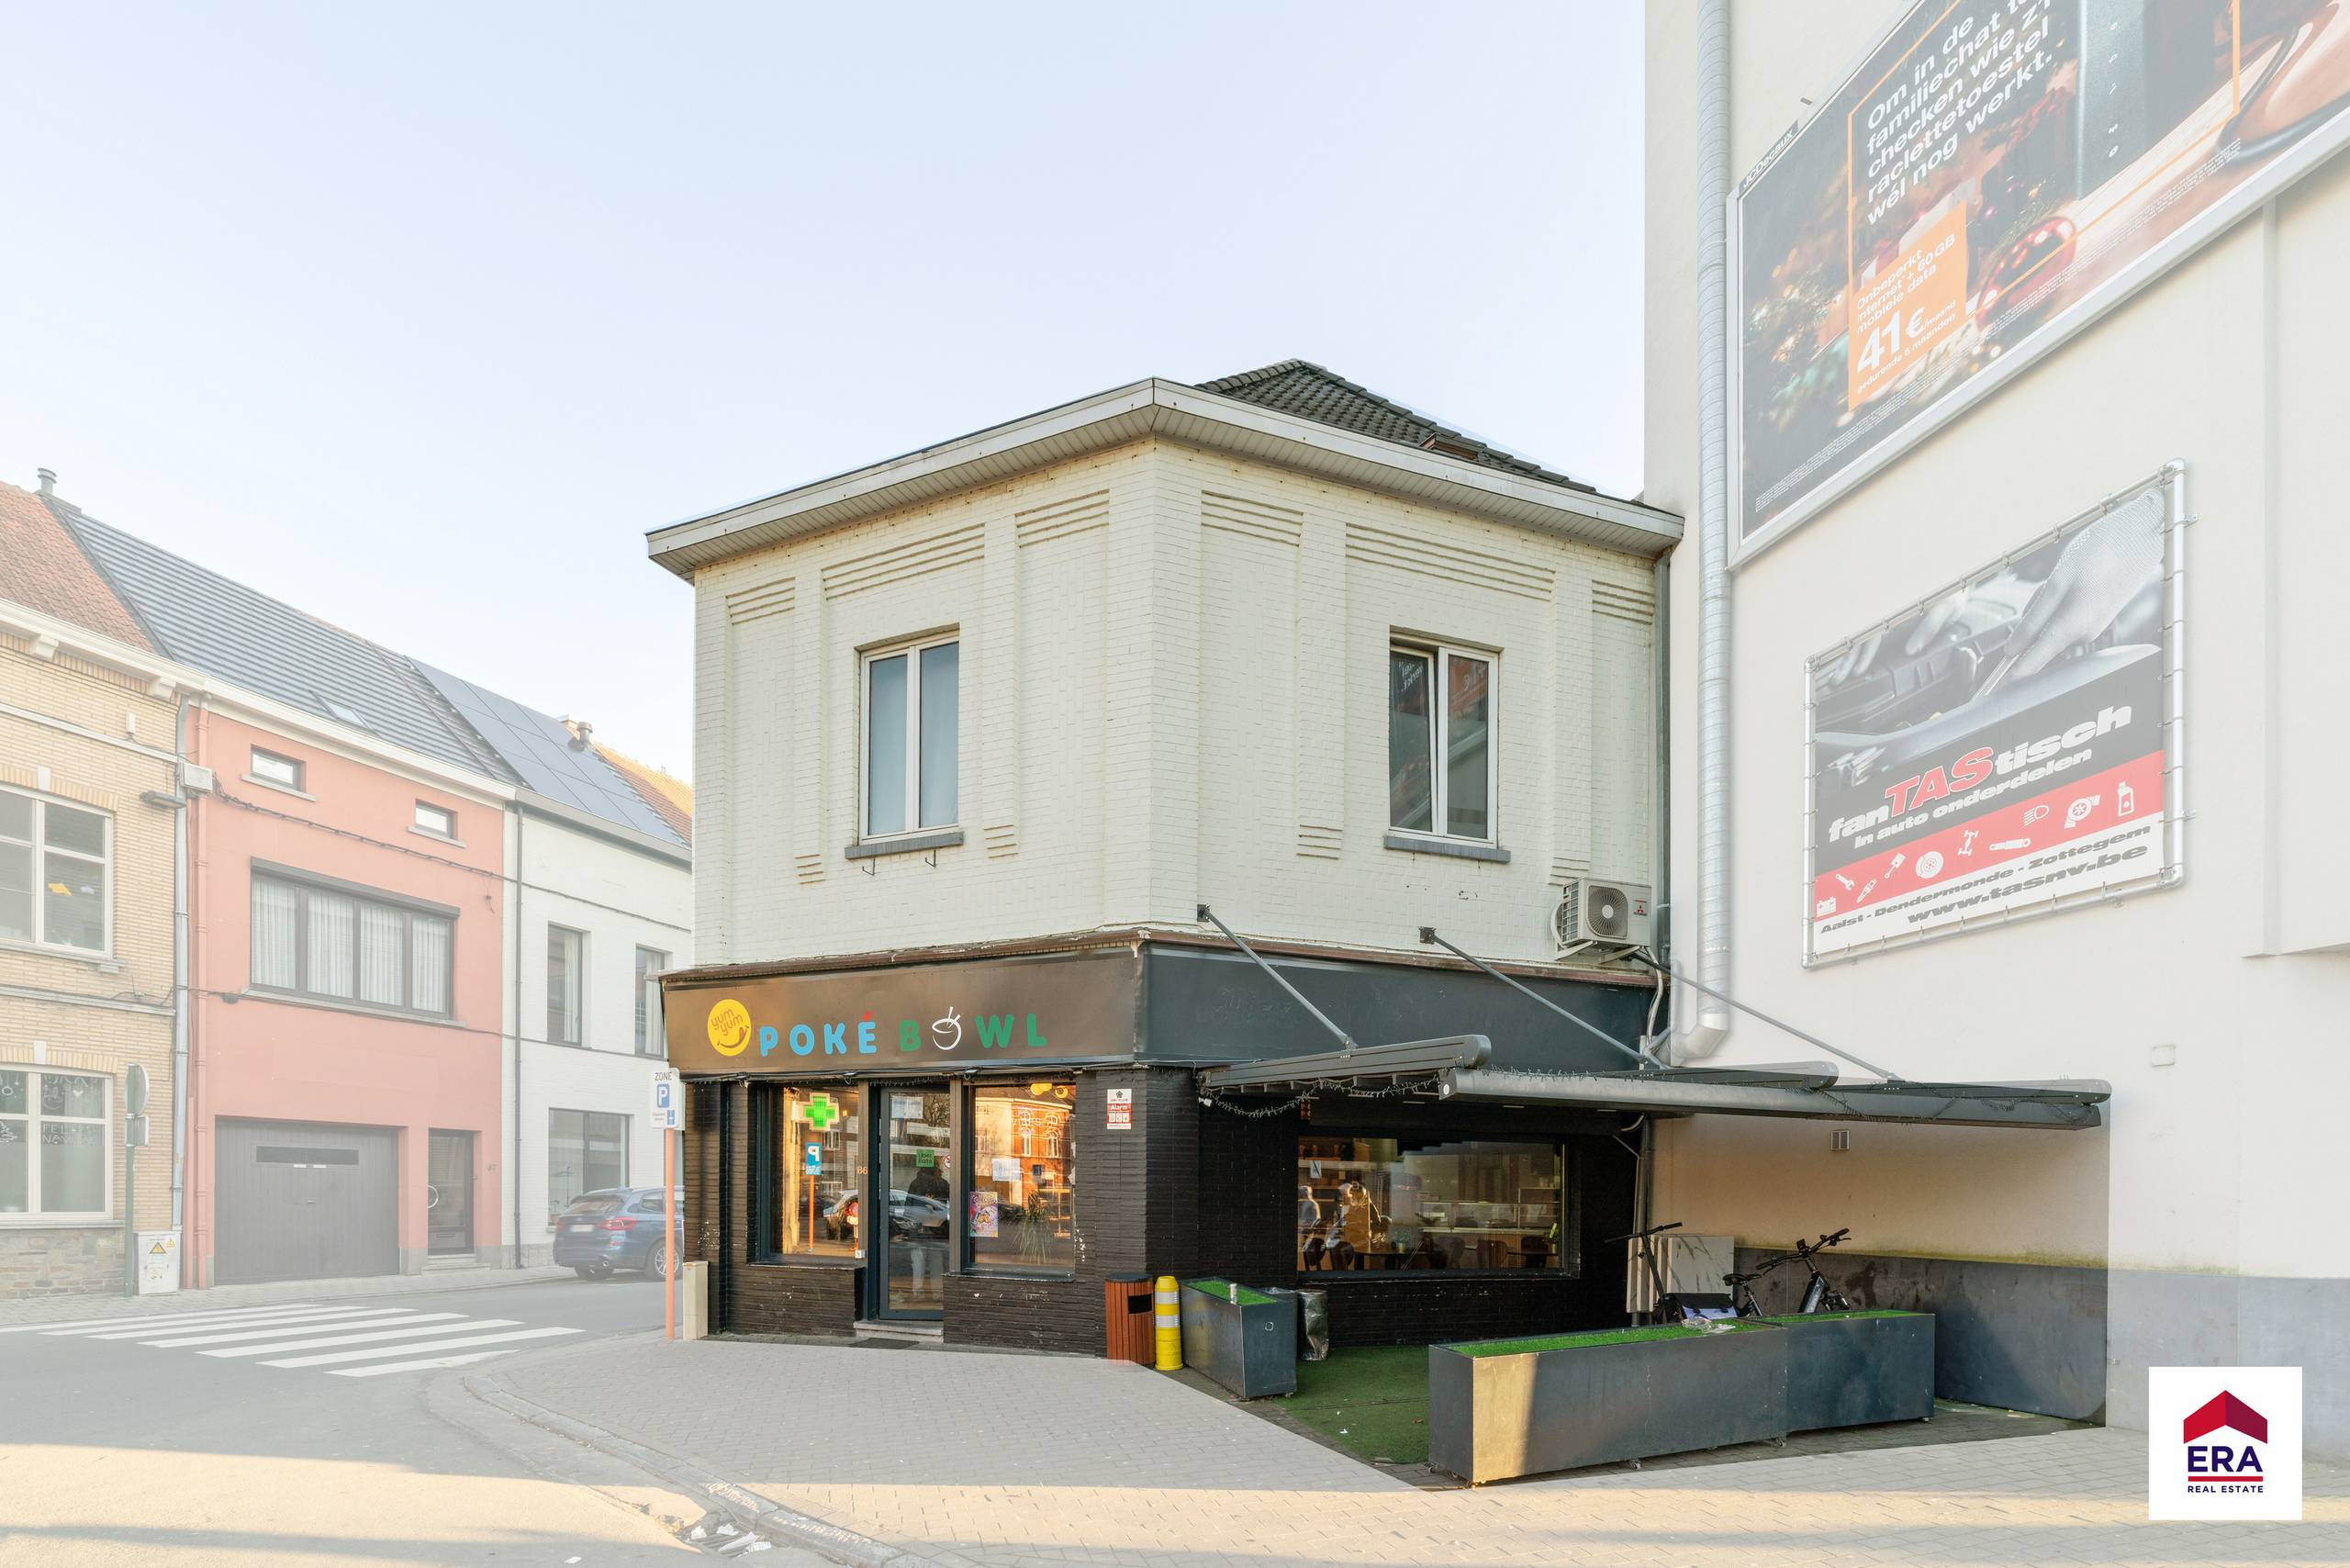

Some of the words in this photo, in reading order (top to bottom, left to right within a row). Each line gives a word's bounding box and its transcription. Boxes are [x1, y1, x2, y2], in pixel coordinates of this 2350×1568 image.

[1867, 11, 2000, 155] familiechat
[1868, 84, 1907, 129] Om
[1915, 55, 1934, 85] in
[1942, 17, 1974, 54] de
[1868, 78, 1963, 178] checken
[1970, 28, 2014, 78] wie
[1867, 177, 1906, 225] wél
[1913, 132, 1958, 185] nog
[1965, 50, 2053, 133] werkt.
[1868, 15, 2048, 204] raclettetoestel
[1744, 129, 1793, 188] JCDecaux
[1857, 278, 1902, 324] internet
[1934, 234, 1955, 257] GB
[1857, 249, 1922, 310] Onbeperkt
[1857, 292, 1905, 335] mobiele
[1908, 263, 1936, 294] data
[1857, 309, 1900, 374] 41
[1911, 313, 1956, 351] maanden
[1829, 705, 2132, 843] fanTAStisch
[1854, 834, 1874, 849] in
[1876, 812, 1929, 841] auto
[1932, 748, 2092, 819] onderdelen
[1820, 913, 1864, 934] Aalst
[1874, 867, 2014, 918] Dendermonde
[2029, 825, 2151, 870] Zottegem
[1907, 846, 2148, 924] www.tasnv.be
[711, 1009, 734, 1030] yum
[720, 1014, 744, 1036] yum
[759, 1011, 878, 1057] POKÉ
[655, 1071, 673, 1081] ZONE
[658, 1086, 668, 1106] P
[857, 1166, 868, 1175] 86
